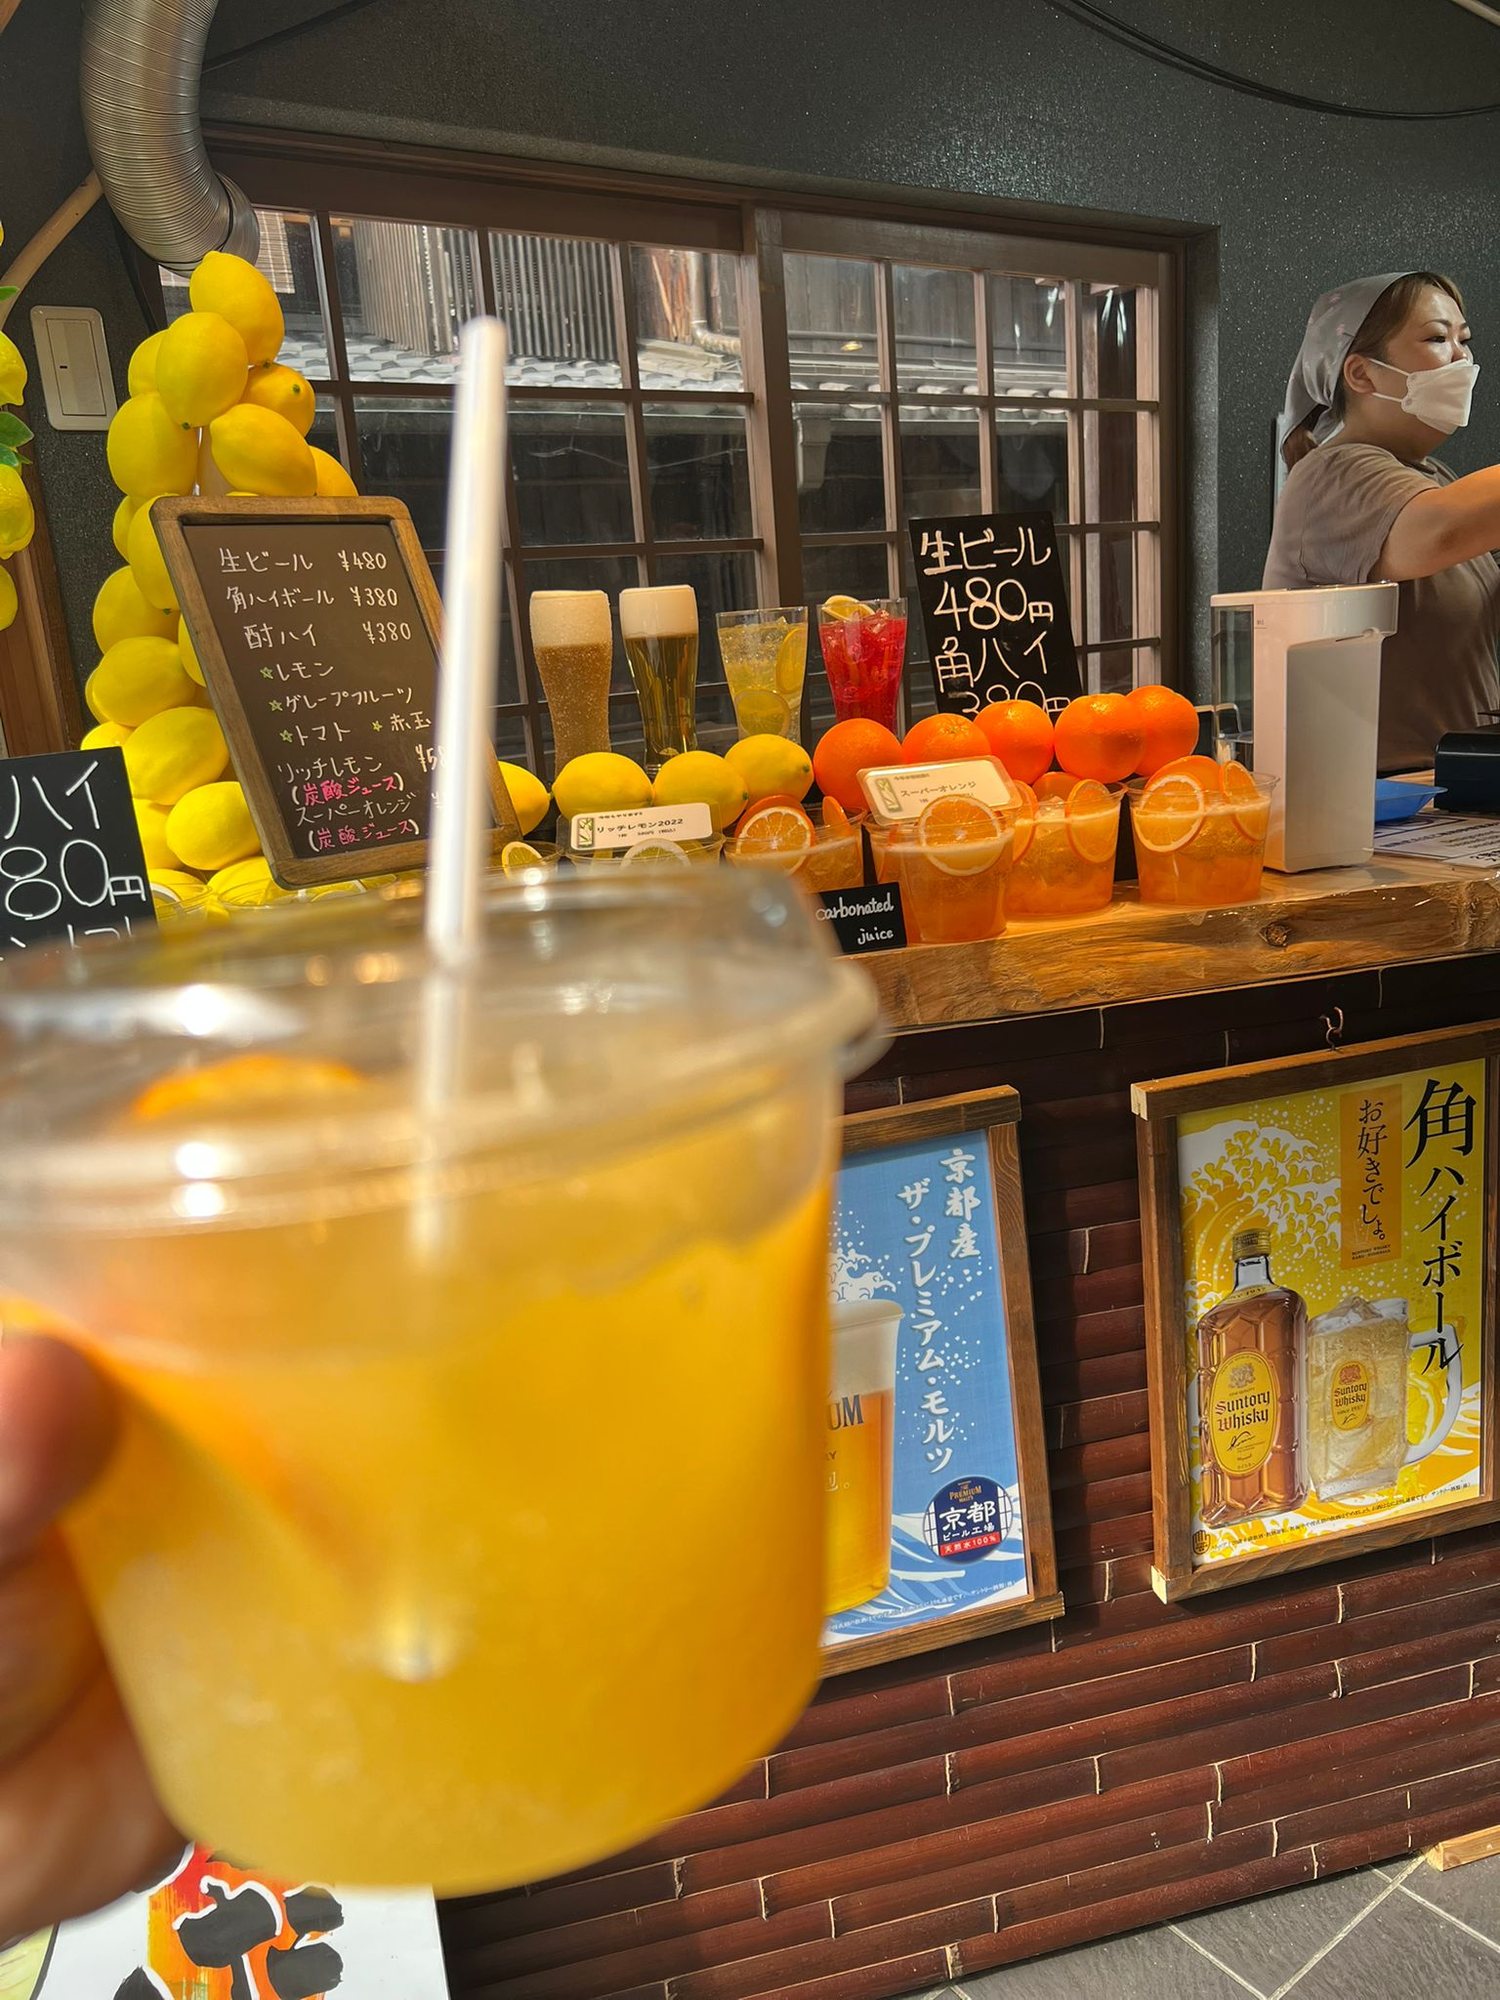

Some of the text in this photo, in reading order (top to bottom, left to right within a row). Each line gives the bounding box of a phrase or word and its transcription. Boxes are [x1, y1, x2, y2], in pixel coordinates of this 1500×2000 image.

[219, 547, 387, 575] 生ビール ¥480
[920, 526, 1051, 575] 生ビール
[226, 585, 398, 613] 角ハイボール ¥380
[933, 576, 1054, 631] 480円
[244, 621, 412, 650] 酎ハイ ¥380
[276, 661, 335, 682] レモン
[935, 631, 1048, 693] 角ハイ
[285, 687, 413, 713] グレープフルーツ
[296, 710, 432, 746] トマト 赤玉
[278, 755, 383, 784] リッチレモン
[297, 791, 417, 827] スーパーオレンジ
[597, 818, 684, 833] リッチレモン2022
[816, 892, 894, 922] carbonated
[857, 927, 894, 946] juice
[1357, 1099, 1389, 1242] お好きでしょ。
[939, 1148, 982, 1259] 京都産
[1403, 1078, 1478, 1376] 角ハイボール
[897, 1177, 955, 1475] ザ・プレミアム・モルツ
[1215, 1391, 1270, 1415] Suntory
[1334, 1383, 1367, 1397] Suntory
[1334, 1394, 1366, 1408] Whisky
[1217, 1409, 1269, 1432] Whisky
[949, 1485, 982, 1500] PREMIUM
[939, 1501, 996, 1531] 京都
[943, 1522, 995, 1541] ビール工場
[944, 1535, 997, 1553] 天然水100%
